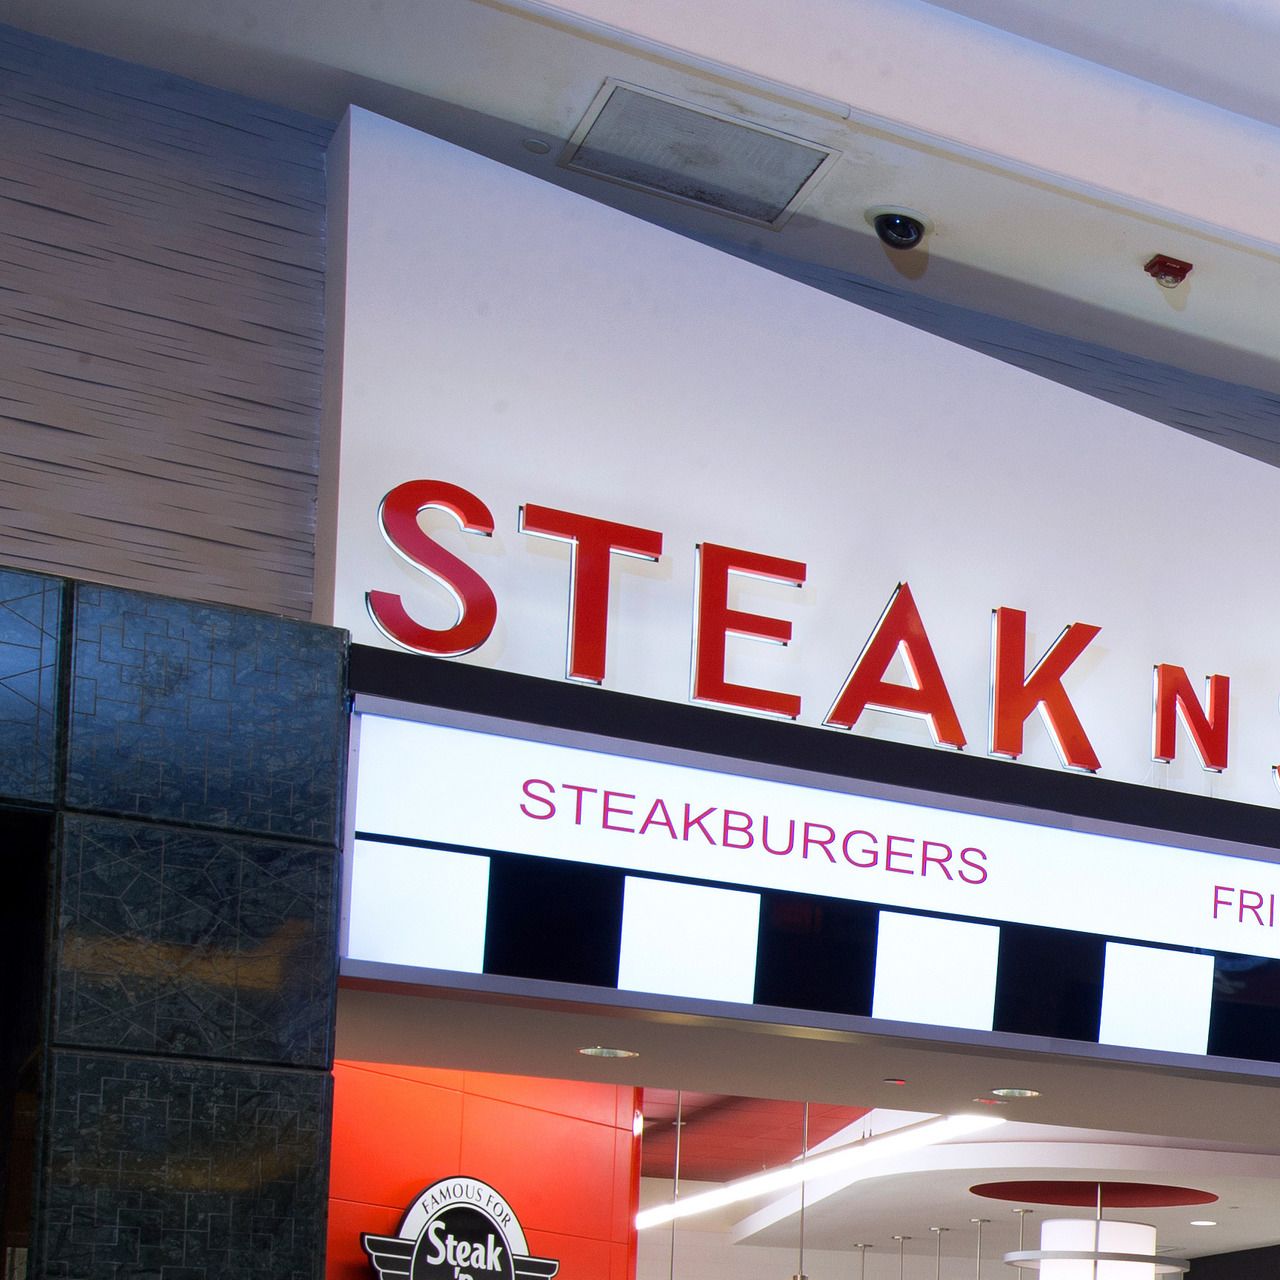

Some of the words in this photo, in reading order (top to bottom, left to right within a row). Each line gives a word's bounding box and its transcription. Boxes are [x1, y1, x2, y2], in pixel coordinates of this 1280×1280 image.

[365, 478, 1102, 775] STEAK
[1151, 663, 1230, 773] N
[518, 777, 989, 886] STEAKBURGERS
[421, 1183, 483, 1214] FAMOUS
[486, 1192, 512, 1229] FOR
[426, 1220, 503, 1272] Steak
